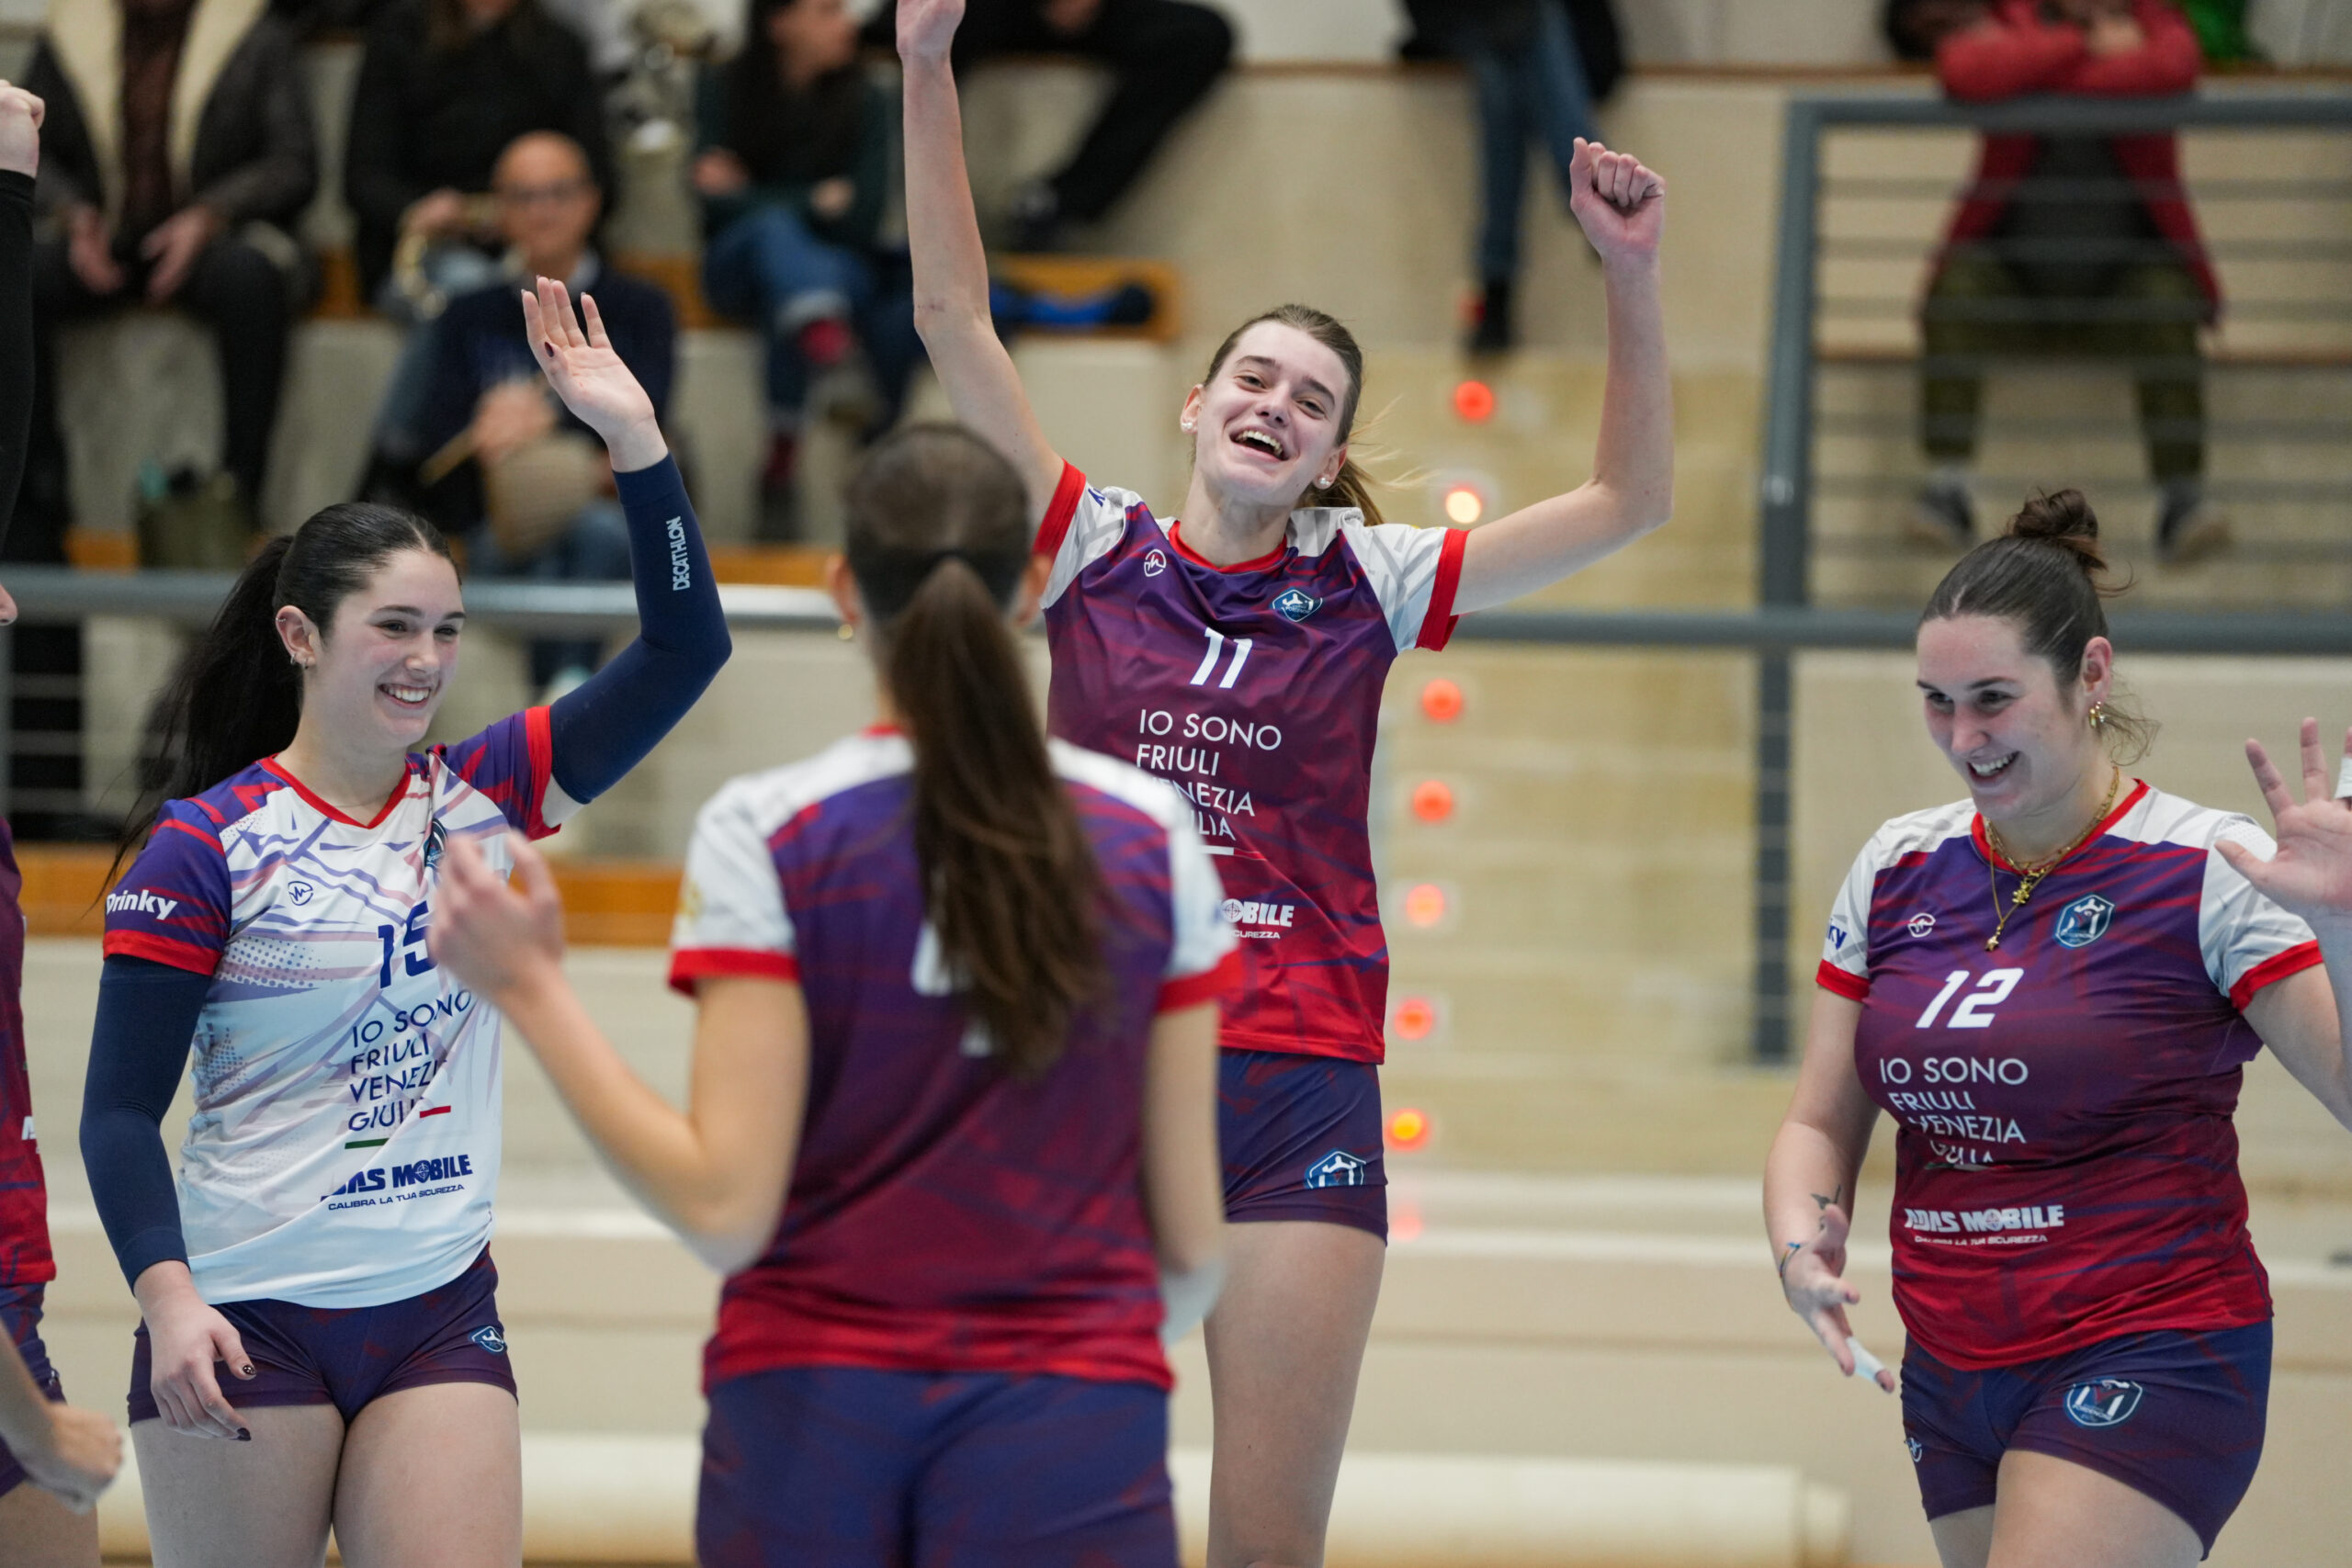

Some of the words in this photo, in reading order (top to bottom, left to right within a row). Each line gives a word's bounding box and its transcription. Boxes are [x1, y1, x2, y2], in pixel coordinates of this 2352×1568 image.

[666, 516, 690, 591] DECATHLON
[1190, 626, 1253, 689] 11
[1139, 709, 1173, 736] IO
[1182, 713, 1282, 750] SONO
[1136, 743, 1219, 776] FRIULI
[1152, 777, 1255, 817] NEZIA
[1222, 898, 1295, 928] OBILE
[378, 900, 439, 989] 15
[1916, 967, 2024, 1028] 12
[353, 1021, 383, 1047] IO
[393, 989, 471, 1032] SONO
[351, 1032, 429, 1074] FRIULI
[1880, 1057, 1912, 1084] IO
[1923, 1056, 2029, 1085] SONO
[350, 1060, 447, 1102] VENEZI
[1888, 1090, 1976, 1111] FRIULI
[1907, 1115, 2027, 1144] VENEZIA
[392, 1155, 473, 1188] MOBILE
[328, 1198, 376, 1211] CALIBRA
[379, 1196, 393, 1204] LA
[396, 1192, 417, 1201] TUA
[418, 1184, 465, 1198] SICUREZZA
[1960, 1204, 2064, 1232] MOBILE
[1987, 1235, 2048, 1245] SICUREZZA
